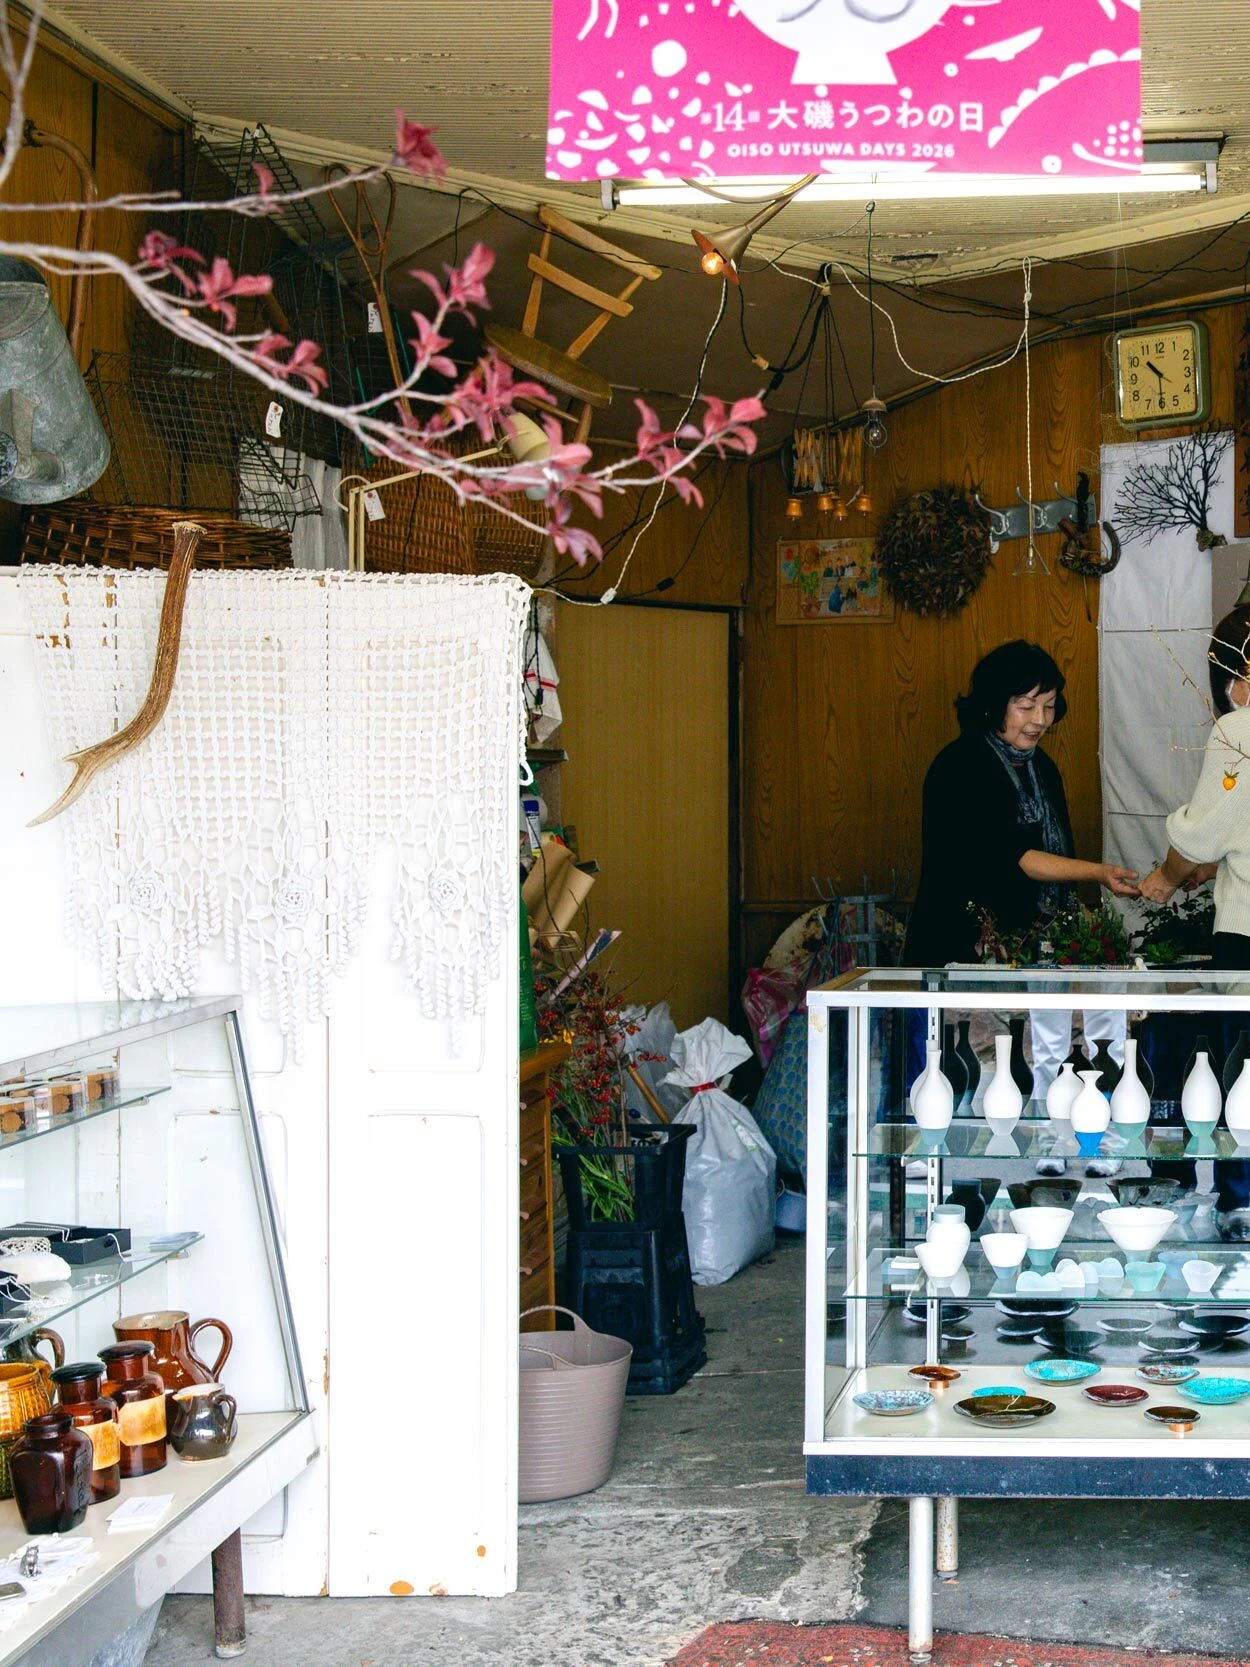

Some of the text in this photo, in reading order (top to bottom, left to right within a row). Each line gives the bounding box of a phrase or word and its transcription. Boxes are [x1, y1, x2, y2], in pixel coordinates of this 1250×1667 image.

[701, 100, 983, 132] 14 大磯うつわの日
[727, 142, 956, 158] OISO UTSUWA DAYS 2026
[1141, 345, 1150, 356] 11
[1155, 342, 1165, 353] 12
[1182, 349, 1190, 361] 2
[1130, 356, 1140, 368] 10
[1184, 367, 1192, 378] 3
[1130, 373, 1138, 385] 9
[1184, 383, 1191, 395] 4
[1132, 390, 1140, 402] 8
[1172, 395, 1179, 407] 5
[1145, 398, 1152, 410] 7
[1158, 397, 1166, 409] 6
